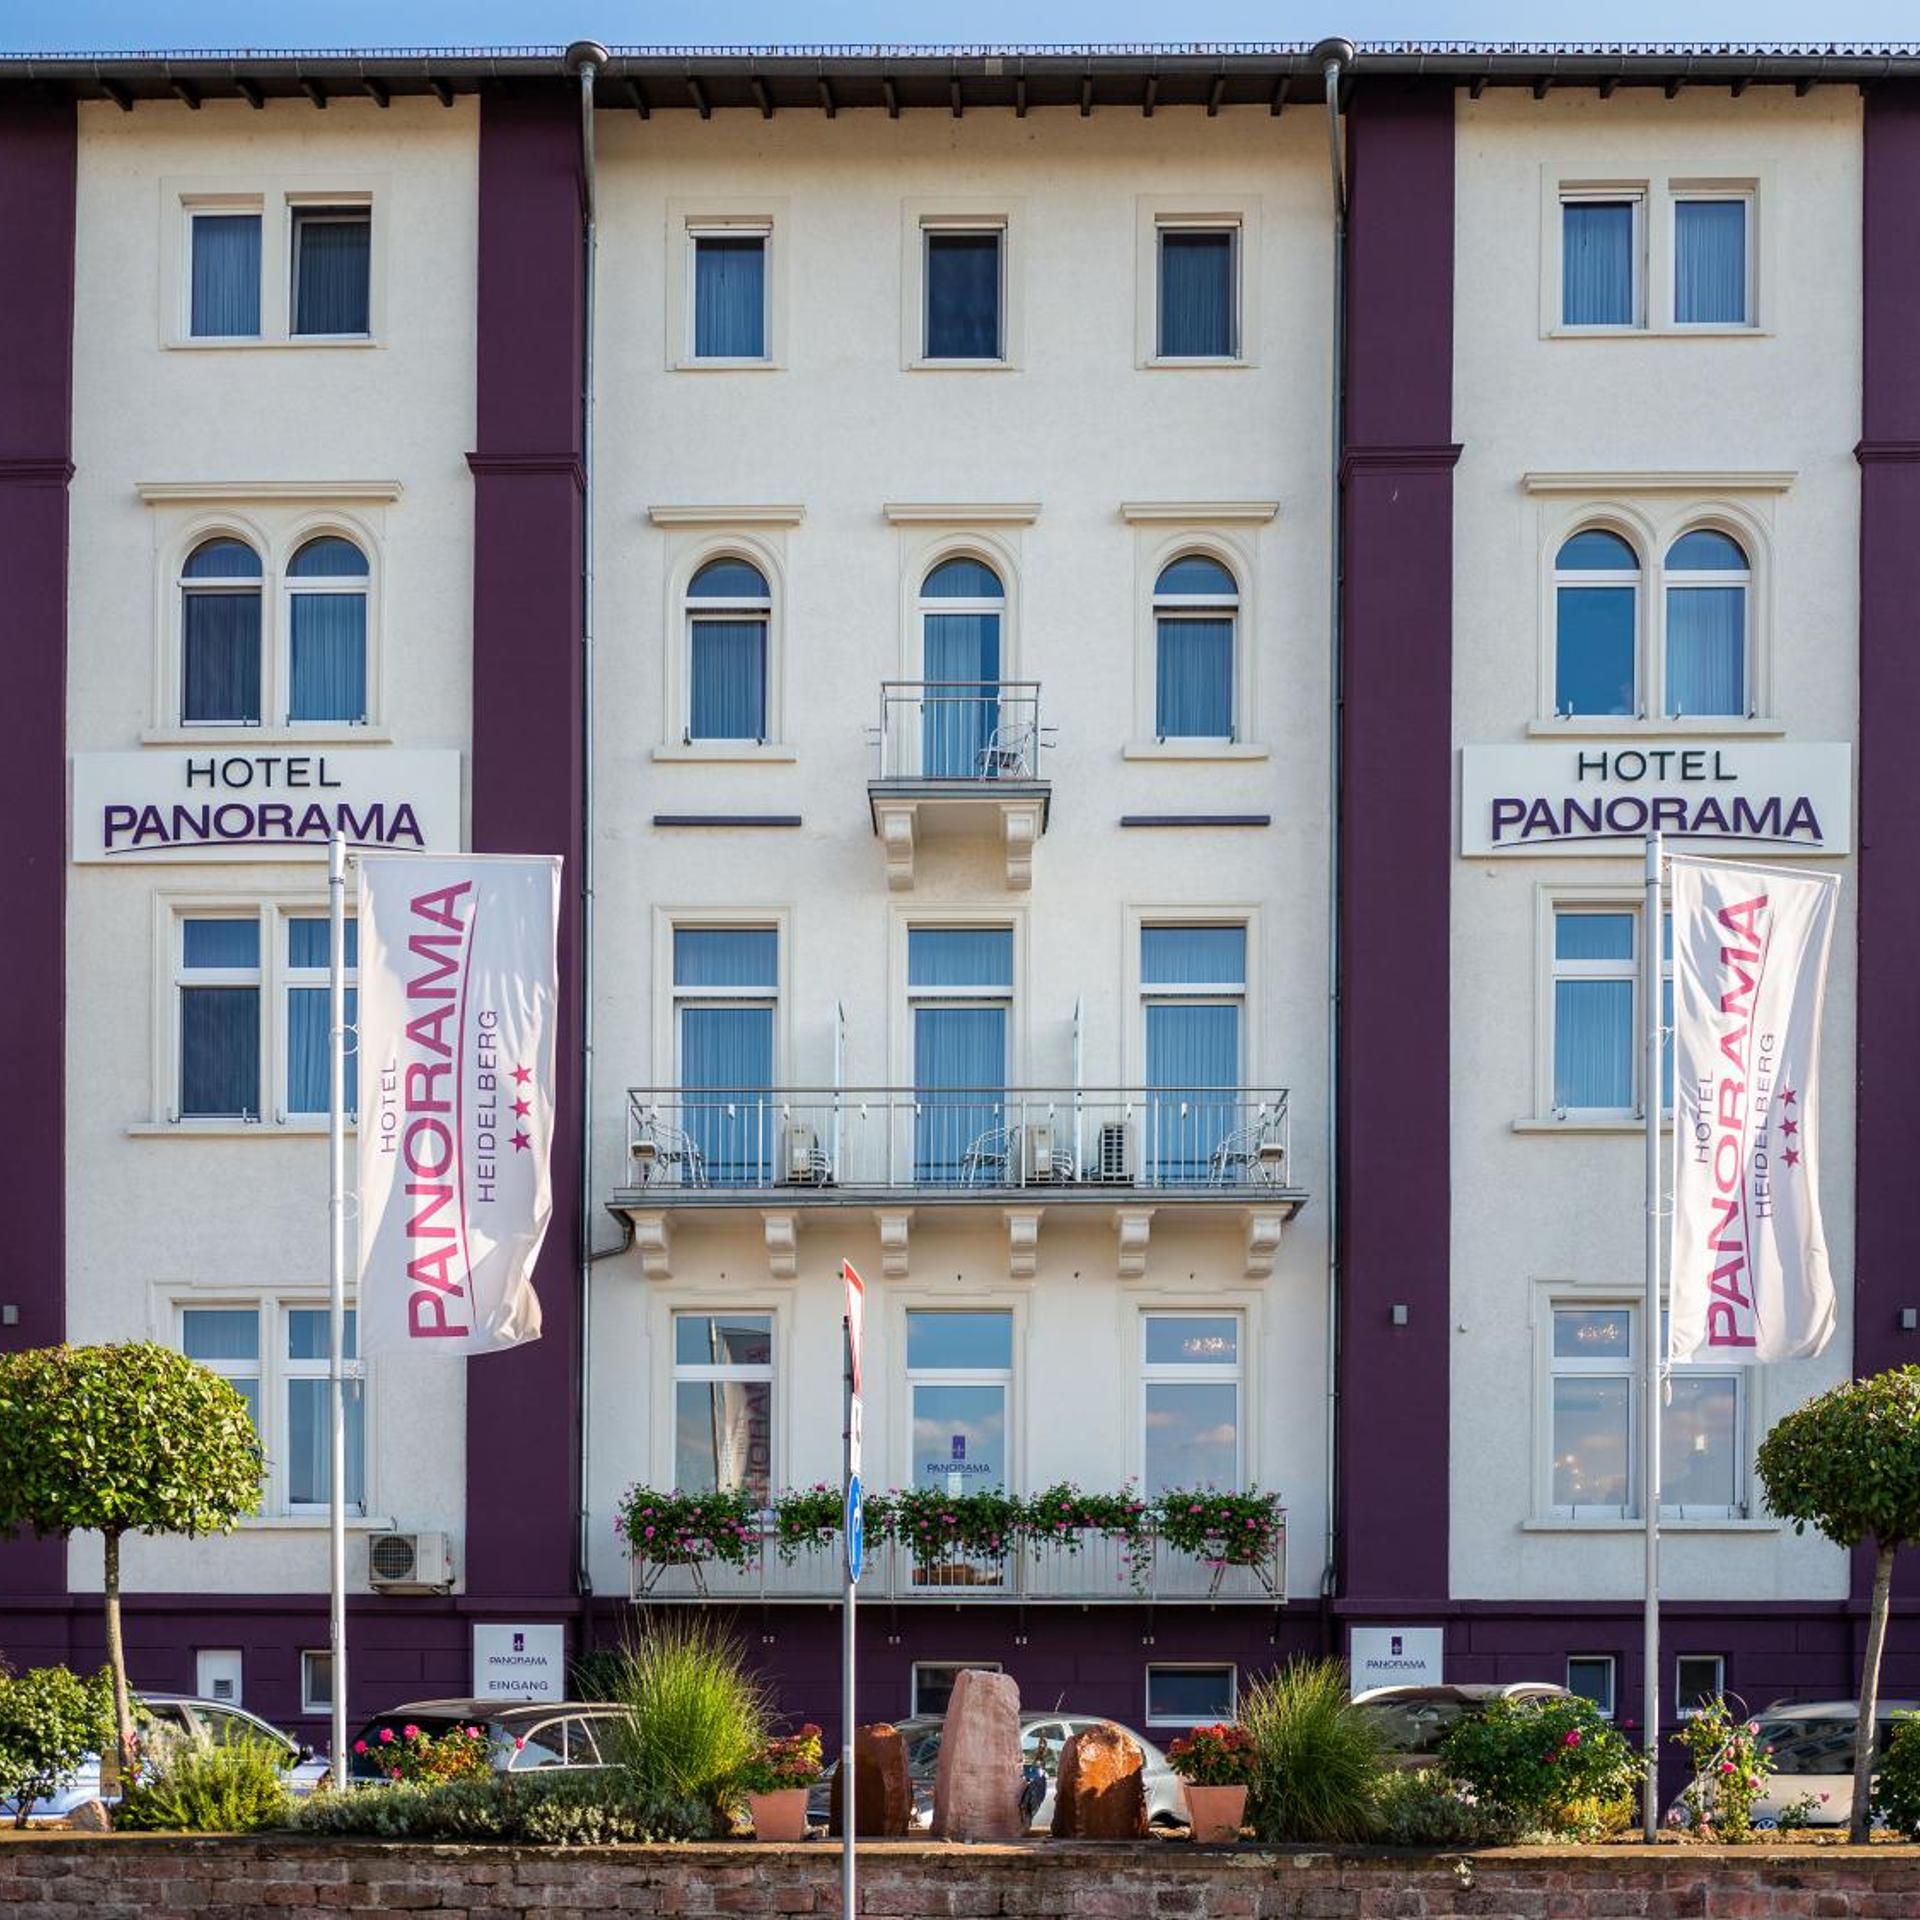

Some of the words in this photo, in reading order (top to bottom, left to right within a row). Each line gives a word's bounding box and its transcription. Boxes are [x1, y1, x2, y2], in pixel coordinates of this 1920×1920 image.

[186, 757, 341, 788] HOTEL
[1577, 750, 1738, 782] HOTEL
[104, 803, 425, 847] PANORAMA
[1491, 796, 1824, 841] PANORAMA
[380, 1057, 397, 1153] HOTEL
[403, 880, 473, 1339] PANORAMA
[477, 1009, 498, 1203] HEIDELBERG
[1694, 1071, 1714, 1164] HOTEL
[1708, 894, 1769, 1348] PANORAMA
[1754, 1032, 1775, 1219] HEIDELBERG
[488, 1680, 549, 1690] EINGANG
